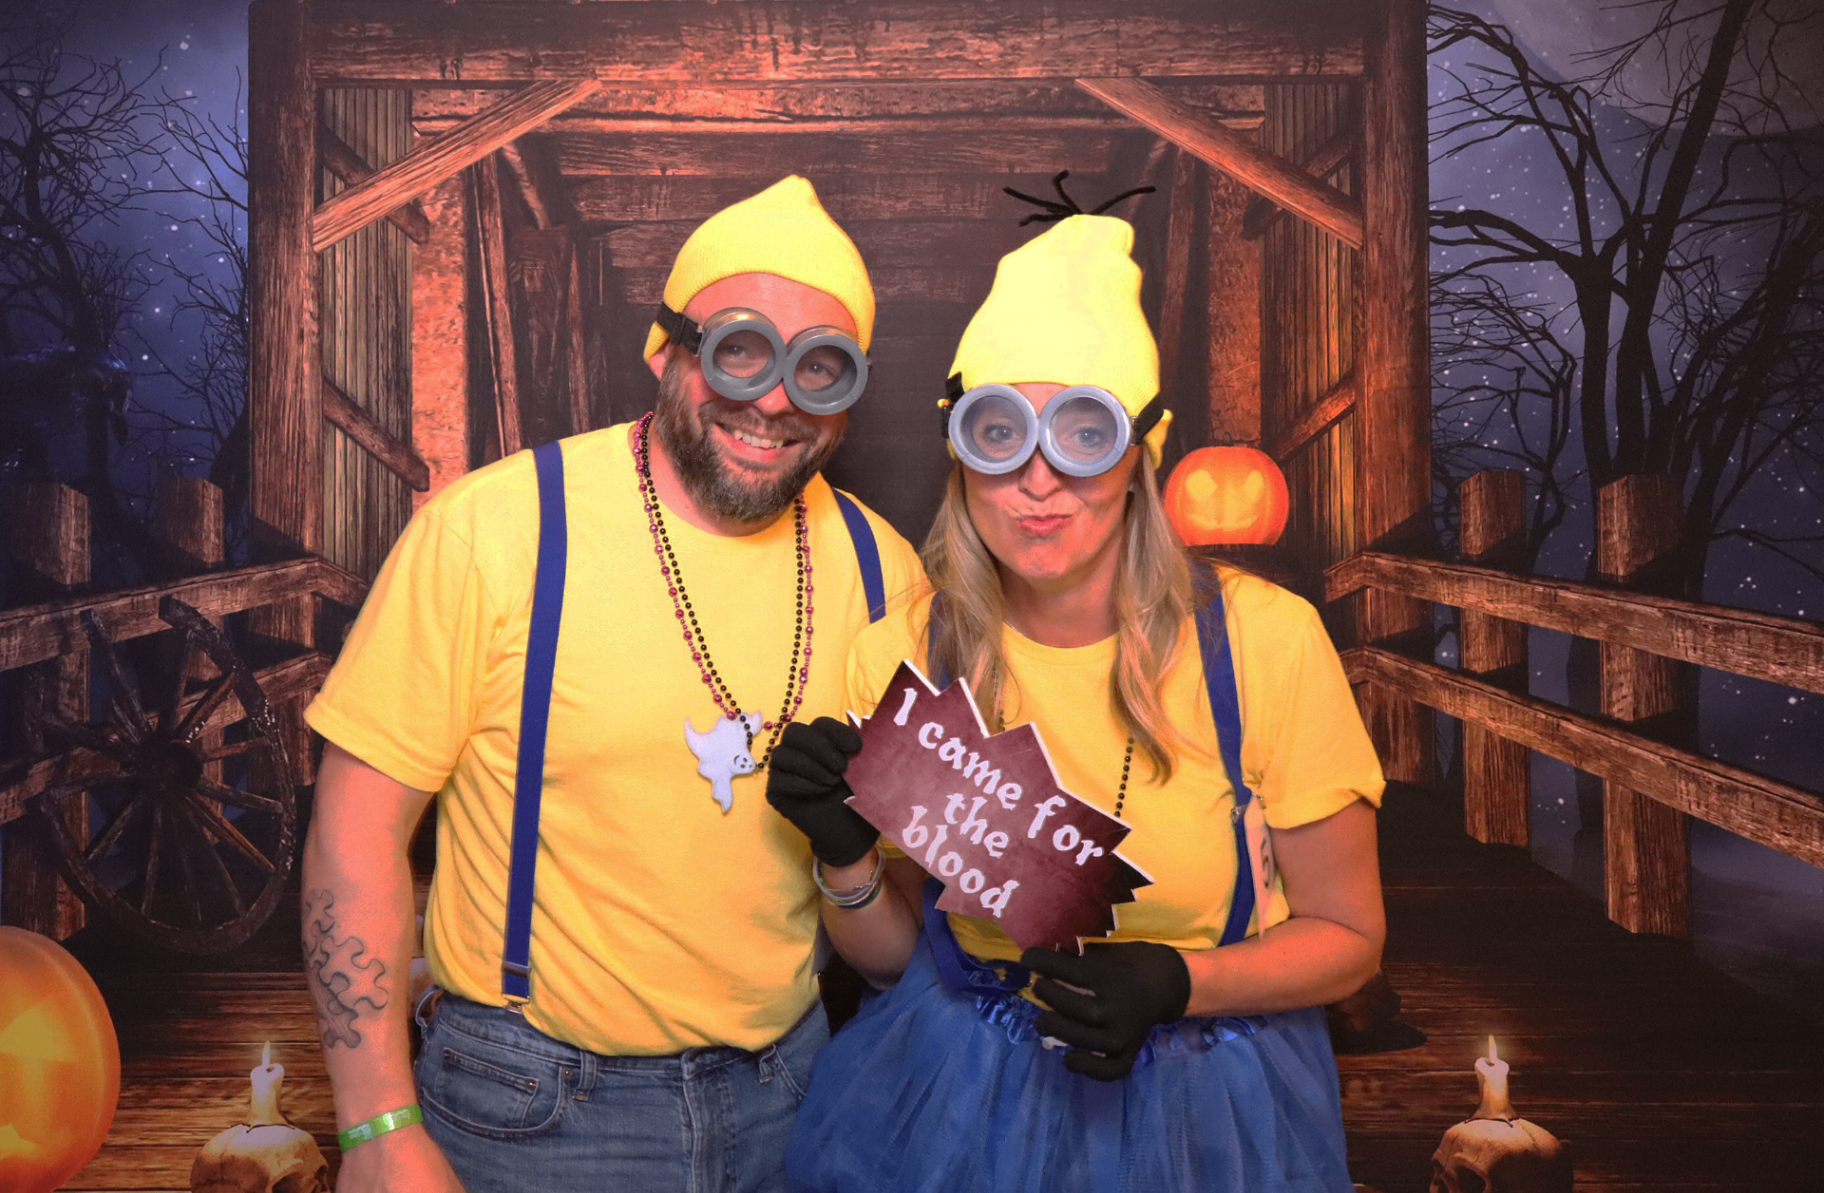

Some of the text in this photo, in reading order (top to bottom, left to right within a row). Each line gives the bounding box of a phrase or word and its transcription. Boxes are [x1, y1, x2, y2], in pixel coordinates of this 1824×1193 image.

[893, 687, 1103, 866] I came for
[944, 793, 1009, 858] the
[901, 805, 1020, 918] blood
